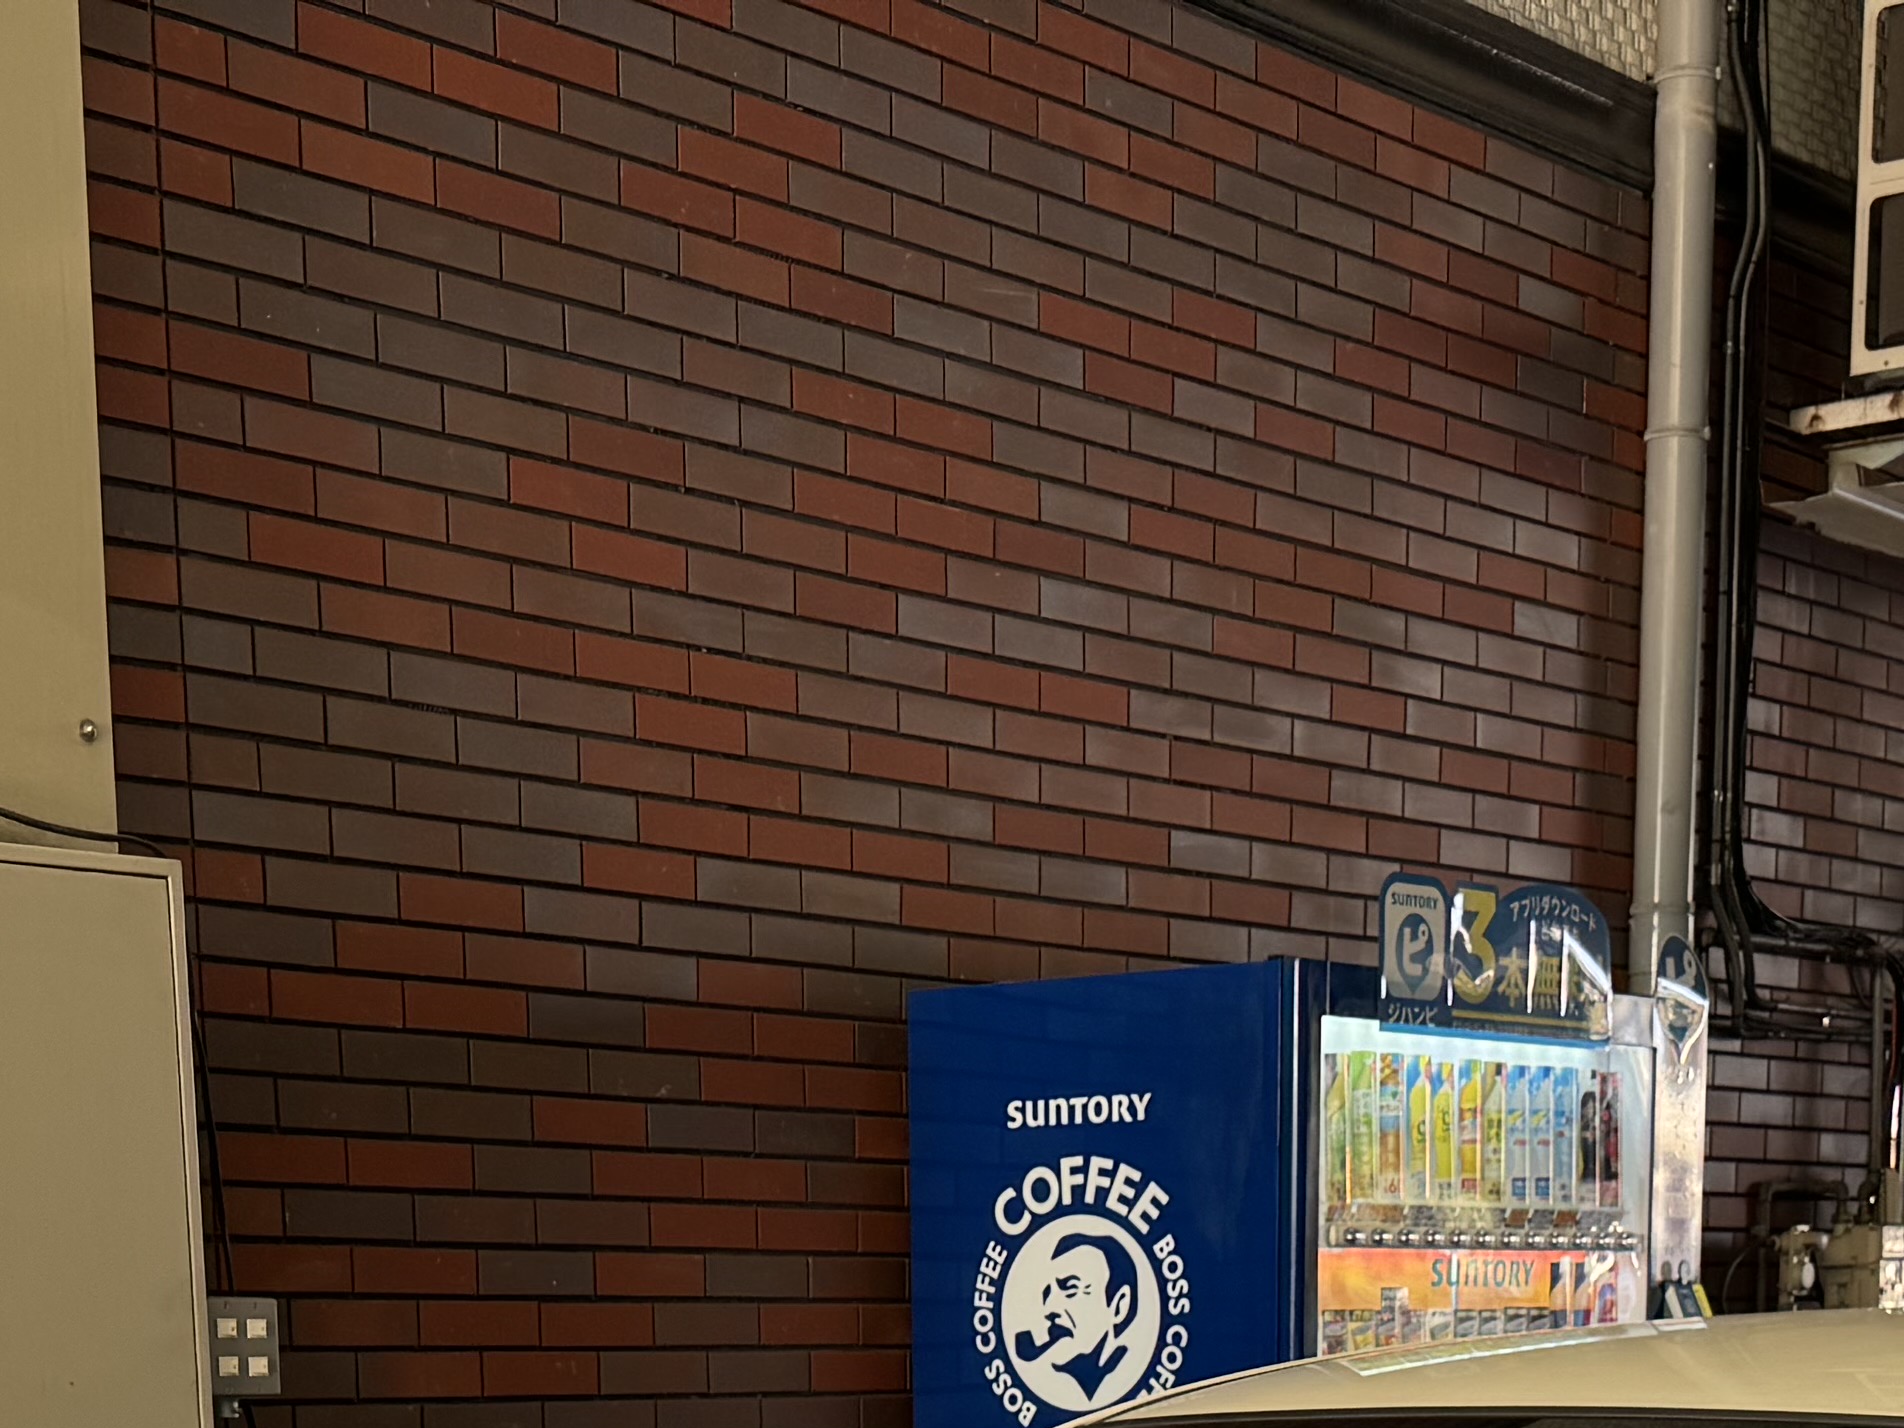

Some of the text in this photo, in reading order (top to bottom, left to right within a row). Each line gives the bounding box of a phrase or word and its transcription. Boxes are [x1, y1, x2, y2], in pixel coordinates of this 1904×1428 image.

[1390, 891, 1438, 911] SUNTORY
[1006, 1092, 1152, 1129] SUNTORY
[994, 1155, 1170, 1236] COFFEE
[973, 1240, 1008, 1353] COFFEE
[1152, 1233, 1190, 1316] BOSS
[1430, 1258, 1535, 1288] SUNTORY
[984, 1358, 1037, 1428] BOSS
